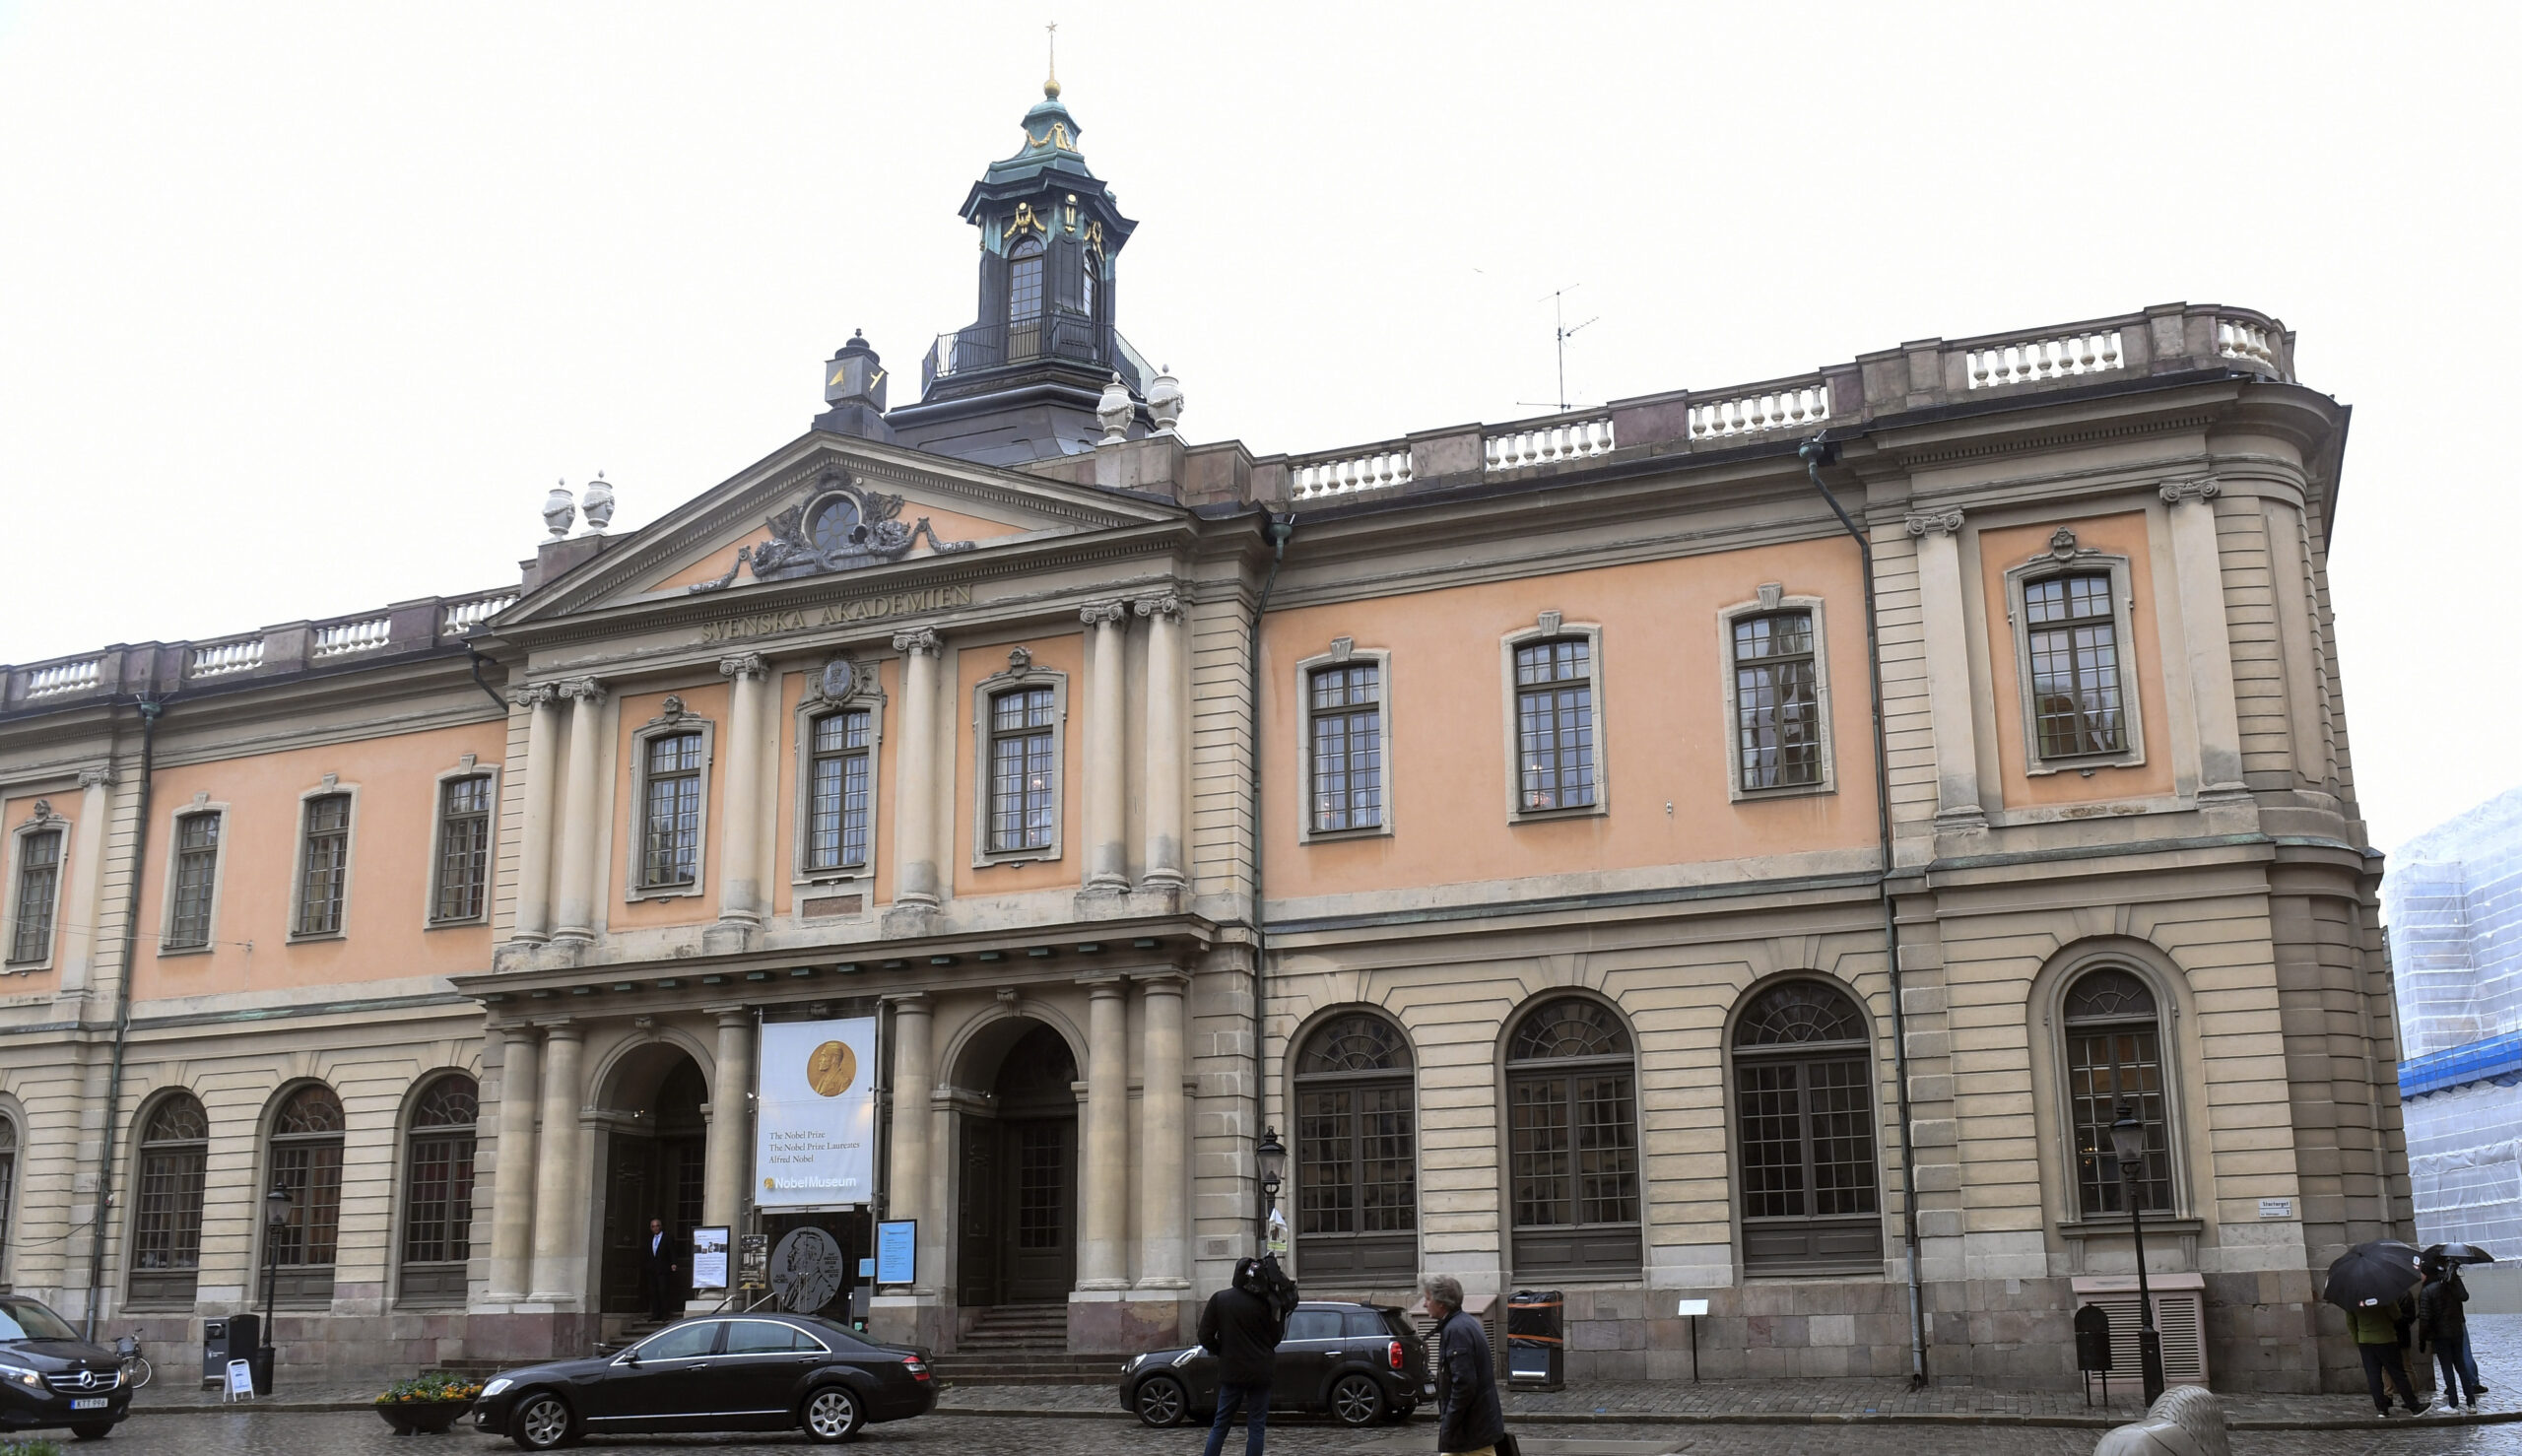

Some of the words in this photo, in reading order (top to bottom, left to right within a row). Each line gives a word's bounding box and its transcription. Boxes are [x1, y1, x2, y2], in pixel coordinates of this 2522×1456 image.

[700, 610, 806, 642] SVENSKA
[821, 583, 973, 626] AKADEMIEN
[784, 1131, 806, 1140] Nobel
[784, 1143, 805, 1152] Nobel
[775, 1176, 856, 1189] NobelMuseum
